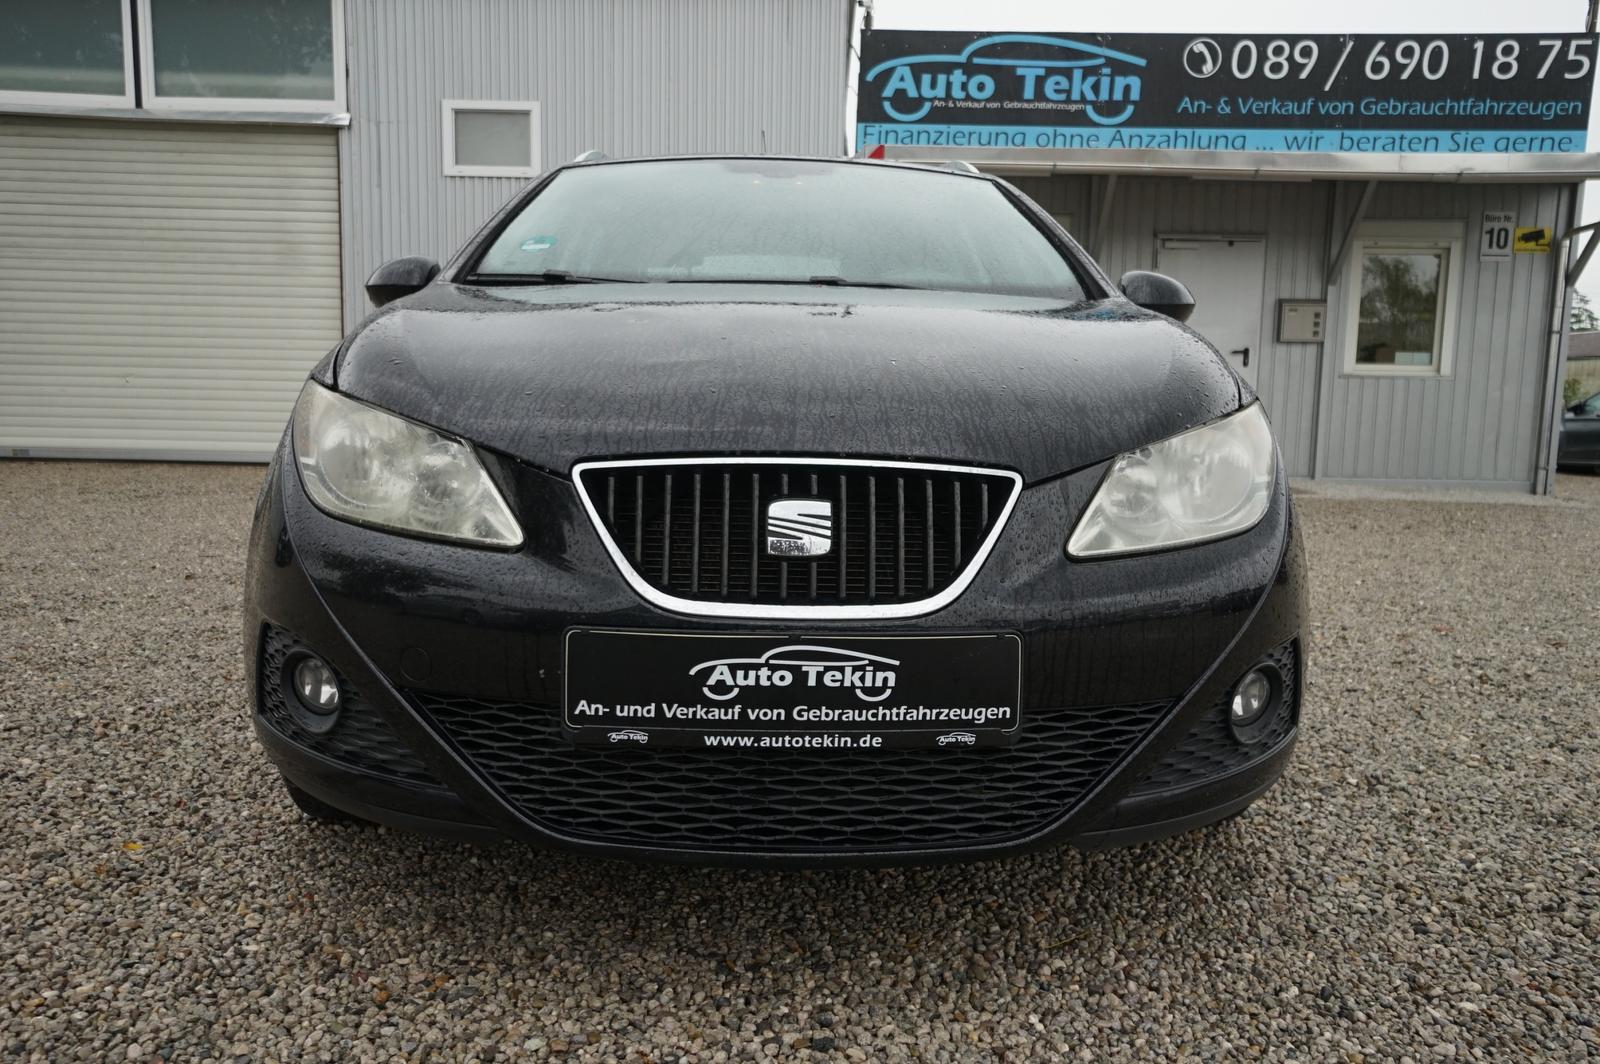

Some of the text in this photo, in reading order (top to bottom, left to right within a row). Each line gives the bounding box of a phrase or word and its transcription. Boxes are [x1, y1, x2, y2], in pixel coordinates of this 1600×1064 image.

[1363, 40, 1450, 81] 690
[1472, 39, 1521, 80] 18
[1536, 39, 1593, 80] 75
[881, 65, 1142, 101] Auto Tekin
[956, 101, 985, 109] Verkauf
[1003, 101, 1085, 112] Gebrauchtfahrzeugen
[1176, 96, 1583, 121] An- & Verkauf von Gebrauchtfahrzeugen
[863, 125, 1027, 147] Finanzierung
[1035, 128, 1100, 149] ohne
[1107, 129, 1247, 151] Anzahlung
[1284, 131, 1325, 151] wir
[1339, 132, 1440, 152] beraten
[1448, 132, 1485, 153] Sie
[1485, 227, 1510, 249] 10
[705, 665, 897, 688] Auto Tekin
[574, 700, 1012, 724] An- und Verkauf von Gebrauchtfahrzeugen
[703, 734, 883, 748] www.autotekin.de
